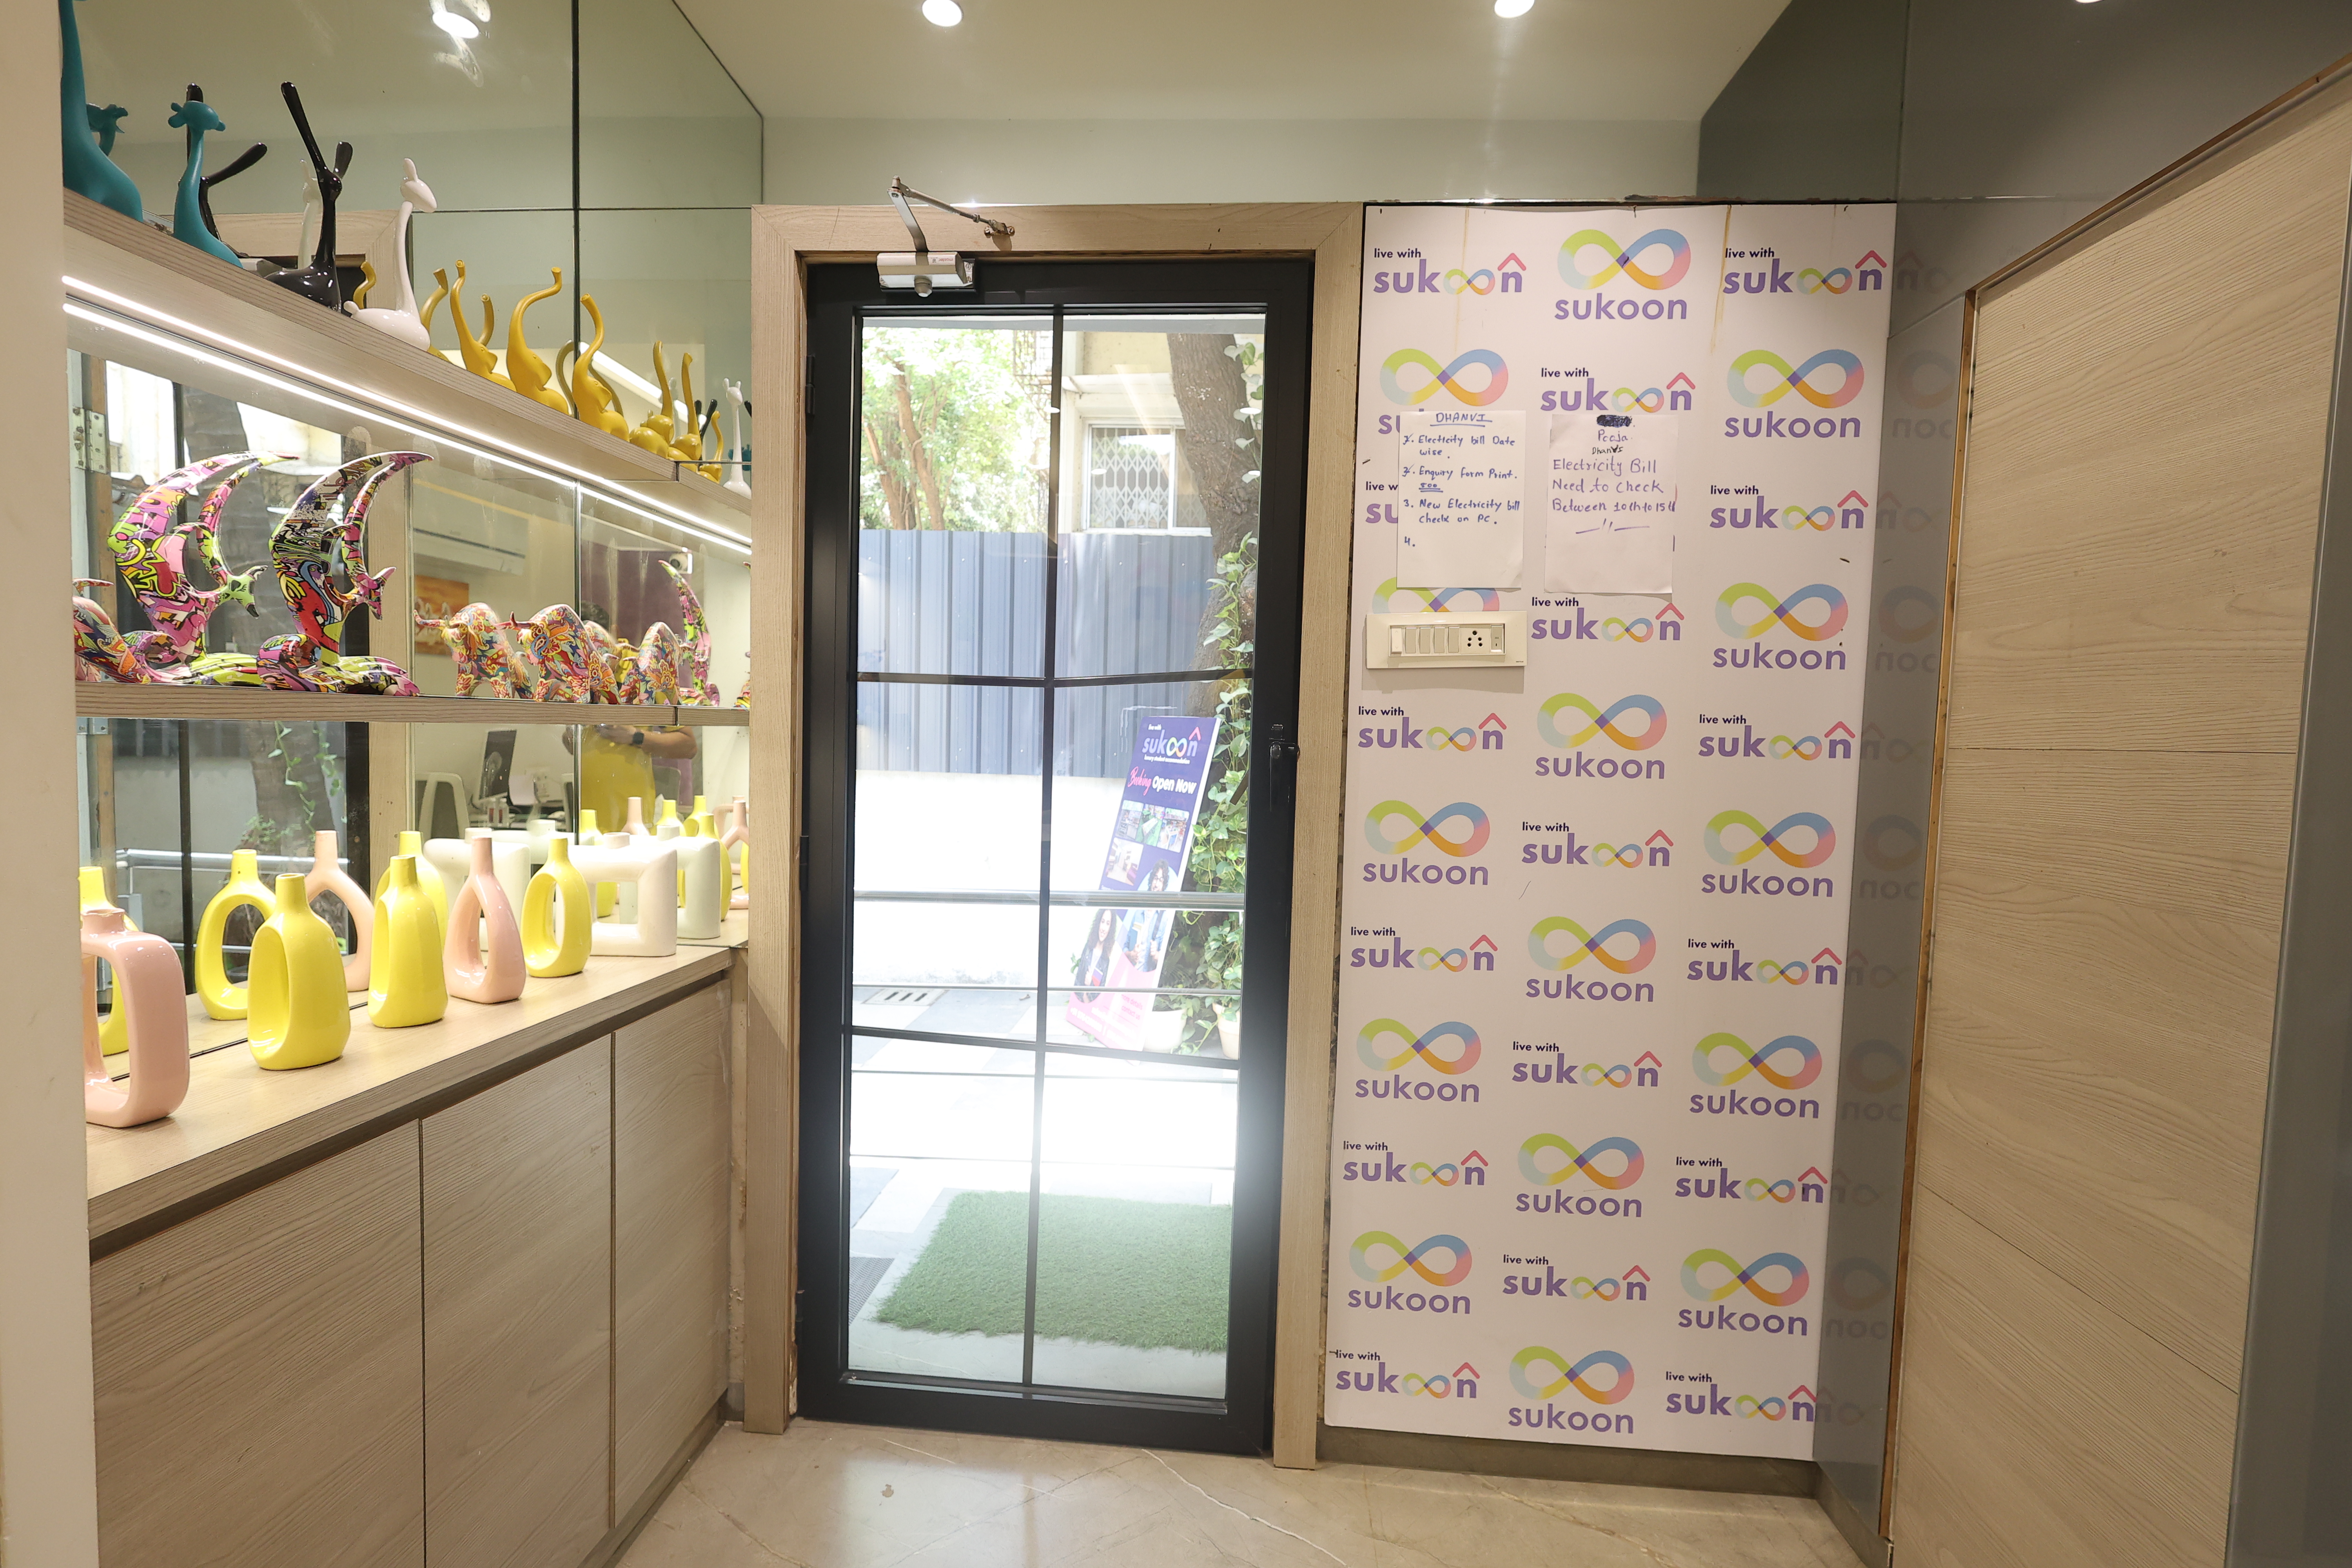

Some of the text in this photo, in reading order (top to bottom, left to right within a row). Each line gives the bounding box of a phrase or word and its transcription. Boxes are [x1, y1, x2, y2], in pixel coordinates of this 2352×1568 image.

[1374, 248, 1421, 258] live with
[1725, 247, 1775, 258] live with
[1555, 293, 1687, 319] sukoon
[1541, 367, 1589, 377] live with
[1436, 412, 1492, 423] DHANVI
[1725, 411, 1860, 438] sukoon
[1471, 436, 1485, 445] bill
[1493, 436, 1515, 446] Date
[1553, 456, 1656, 477] Electricity Bill
[1419, 466, 1453, 481] Enquiry
[1366, 481, 1384, 490] live
[1553, 478, 1584, 493] Need
[1590, 477, 1609, 492] to
[1711, 485, 1759, 495] live with
[1403, 498, 1520, 512] 3. New Electricity bill
[1553, 498, 1607, 512] Between
[1404, 536, 1415, 547] 4.
[1532, 597, 1579, 606] live with
[1713, 643, 1846, 670] sukoon
[1358, 706, 1404, 716] live with
[1699, 714, 1747, 724] live with
[1536, 751, 1664, 779] sukoon
[1152, 775, 1175, 792] Open
[1175, 779, 1197, 795] Now
[1522, 821, 1570, 832] live with
[1363, 858, 1488, 885] sukoon
[1702, 869, 1833, 897] sukoon
[1351, 926, 1396, 936] live with
[1688, 938, 1735, 949] live with
[1526, 975, 1653, 1002] sukoon
[1130, 999, 1143, 1010] details
[1122, 1005, 1136, 1017] contact
[1513, 1041, 1559, 1052] live with
[1356, 1075, 1479, 1102] sukoon
[1690, 1090, 1819, 1118] sukoon
[1343, 1141, 1388, 1151] live with
[1676, 1156, 1722, 1167] live with
[1517, 1189, 1642, 1217] sukoon
[1503, 1254, 1549, 1265] live with
[1348, 1286, 1470, 1314] sukoon
[1679, 1305, 1807, 1336] sukoon
[1335, 1349, 1380, 1361] live with
[1666, 1371, 1712, 1383] live with
[1509, 1403, 1633, 1434] sukoon
